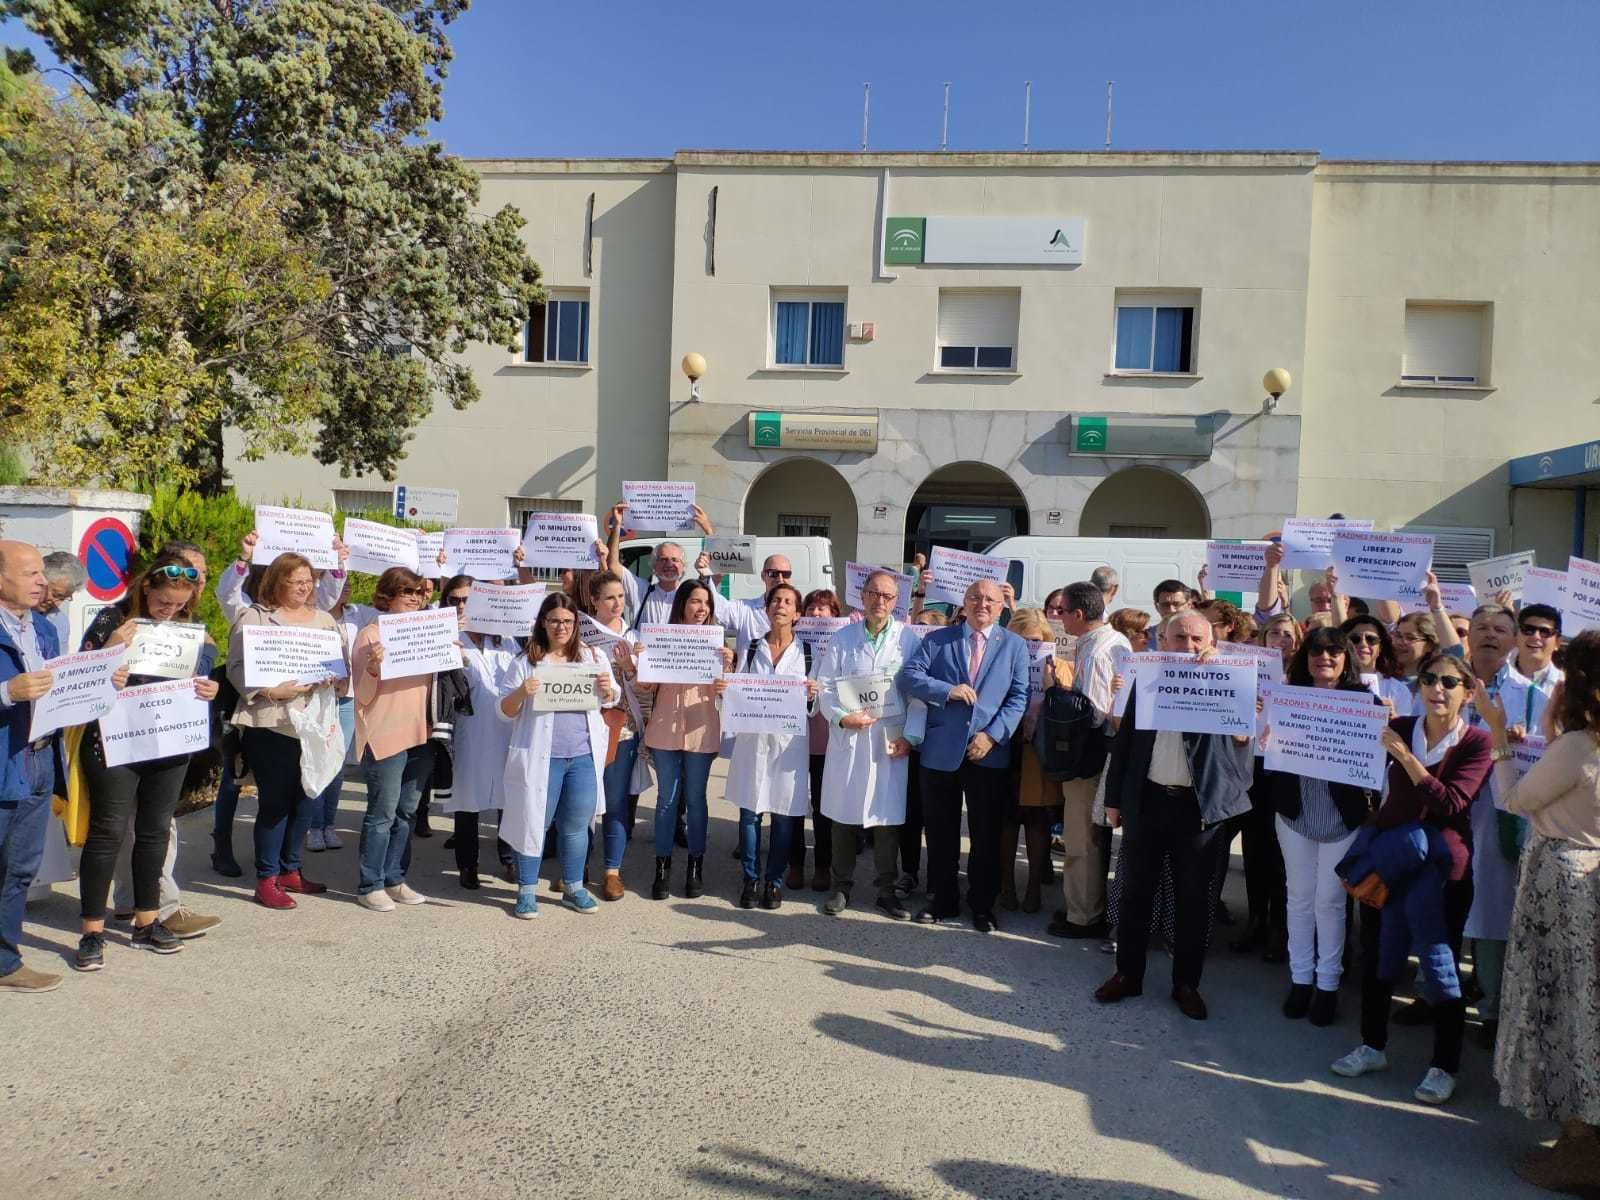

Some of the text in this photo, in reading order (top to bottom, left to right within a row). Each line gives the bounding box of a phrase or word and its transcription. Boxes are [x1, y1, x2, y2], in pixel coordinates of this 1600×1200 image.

[1362, 545, 1403, 554] LIBERTAD
[1358, 556, 1417, 568] PRESCRIPCION
[1486, 571, 1523, 588] 100%
[1139, 655, 1177, 663] RAZONES
[67, 664, 108, 677] MINUTOS
[1164, 670, 1230, 680] 10 MINUTOS
[67, 678, 107, 691] PACIENTE
[543, 683, 593, 694] TODAS
[858, 690, 879, 703] NO
[1158, 686, 1236, 698] POR PACIENTE
[138, 698, 173, 709] ACCESO
[155, 712, 161, 720] A
[1291, 712, 1367, 730] MEDICINA FAMILIAR
[105, 728, 146, 743] PRUEBAS
[1278, 720, 1311, 730] MAXIMO
[1335, 729, 1378, 740] PACIENTES
[1305, 734, 1346, 745] PEDIATRIA
[1278, 738, 1310, 750] MAXIMO
[1332, 747, 1375, 759] PACIENTES
[1282, 748, 1369, 768] AMPLIAR LA PLANTILLA
